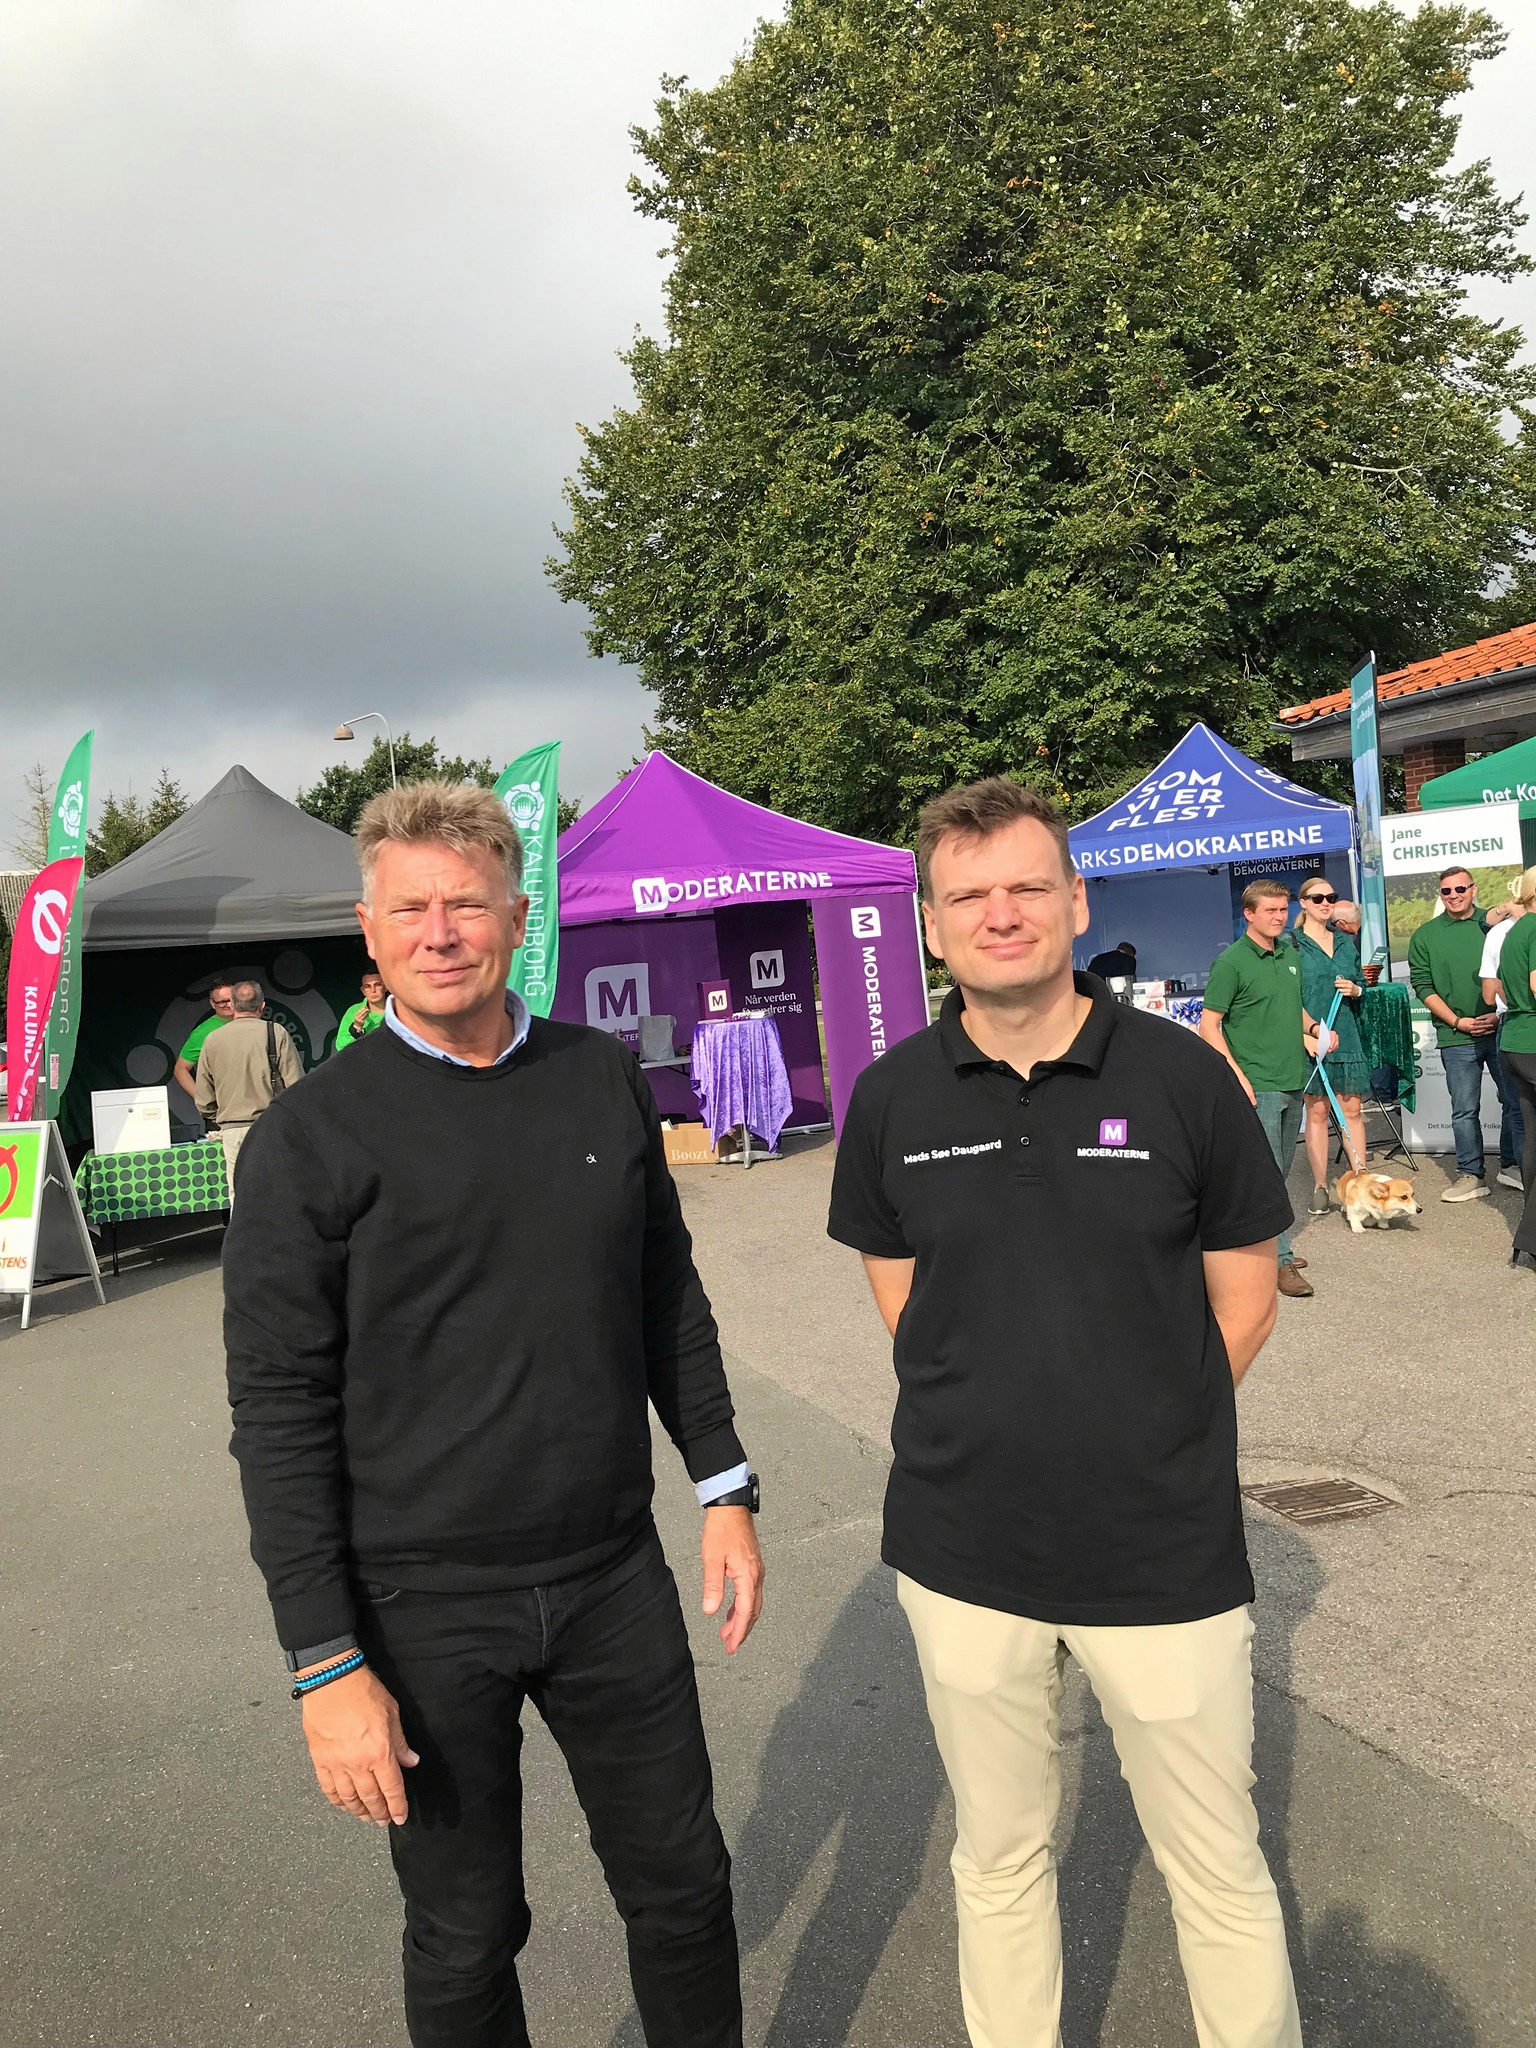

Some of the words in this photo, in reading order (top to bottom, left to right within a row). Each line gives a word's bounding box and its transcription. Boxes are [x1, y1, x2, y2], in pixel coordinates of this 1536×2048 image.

[1136, 769, 1223, 799] SOM
[1127, 795, 1160, 814] VI
[1173, 789, 1223, 805] ER
[1482, 787, 1512, 803] Det
[1106, 805, 1225, 832] FLEST
[1391, 828, 1422, 843] Jane
[1393, 837, 1504, 860] CHRISTENSEN
[1233, 858, 1320, 876] DEMOKRATERNE
[638, 871, 833, 907] MODERATERNE
[523, 834, 547, 997] KALUNDBORG
[598, 978, 638, 1019] M
[745, 994, 762, 1005] Når
[763, 991, 796, 1003] verden
[788, 1001, 803, 1014] sig
[1104, 1124, 1123, 1141] M
[670, 1148, 708, 1160] Boozt
[903, 1151, 930, 1164] Mads
[931, 1149, 950, 1159] Søe
[951, 1139, 1002, 1155] Daugaard
[1077, 1147, 1150, 1160] MODERATERNE
